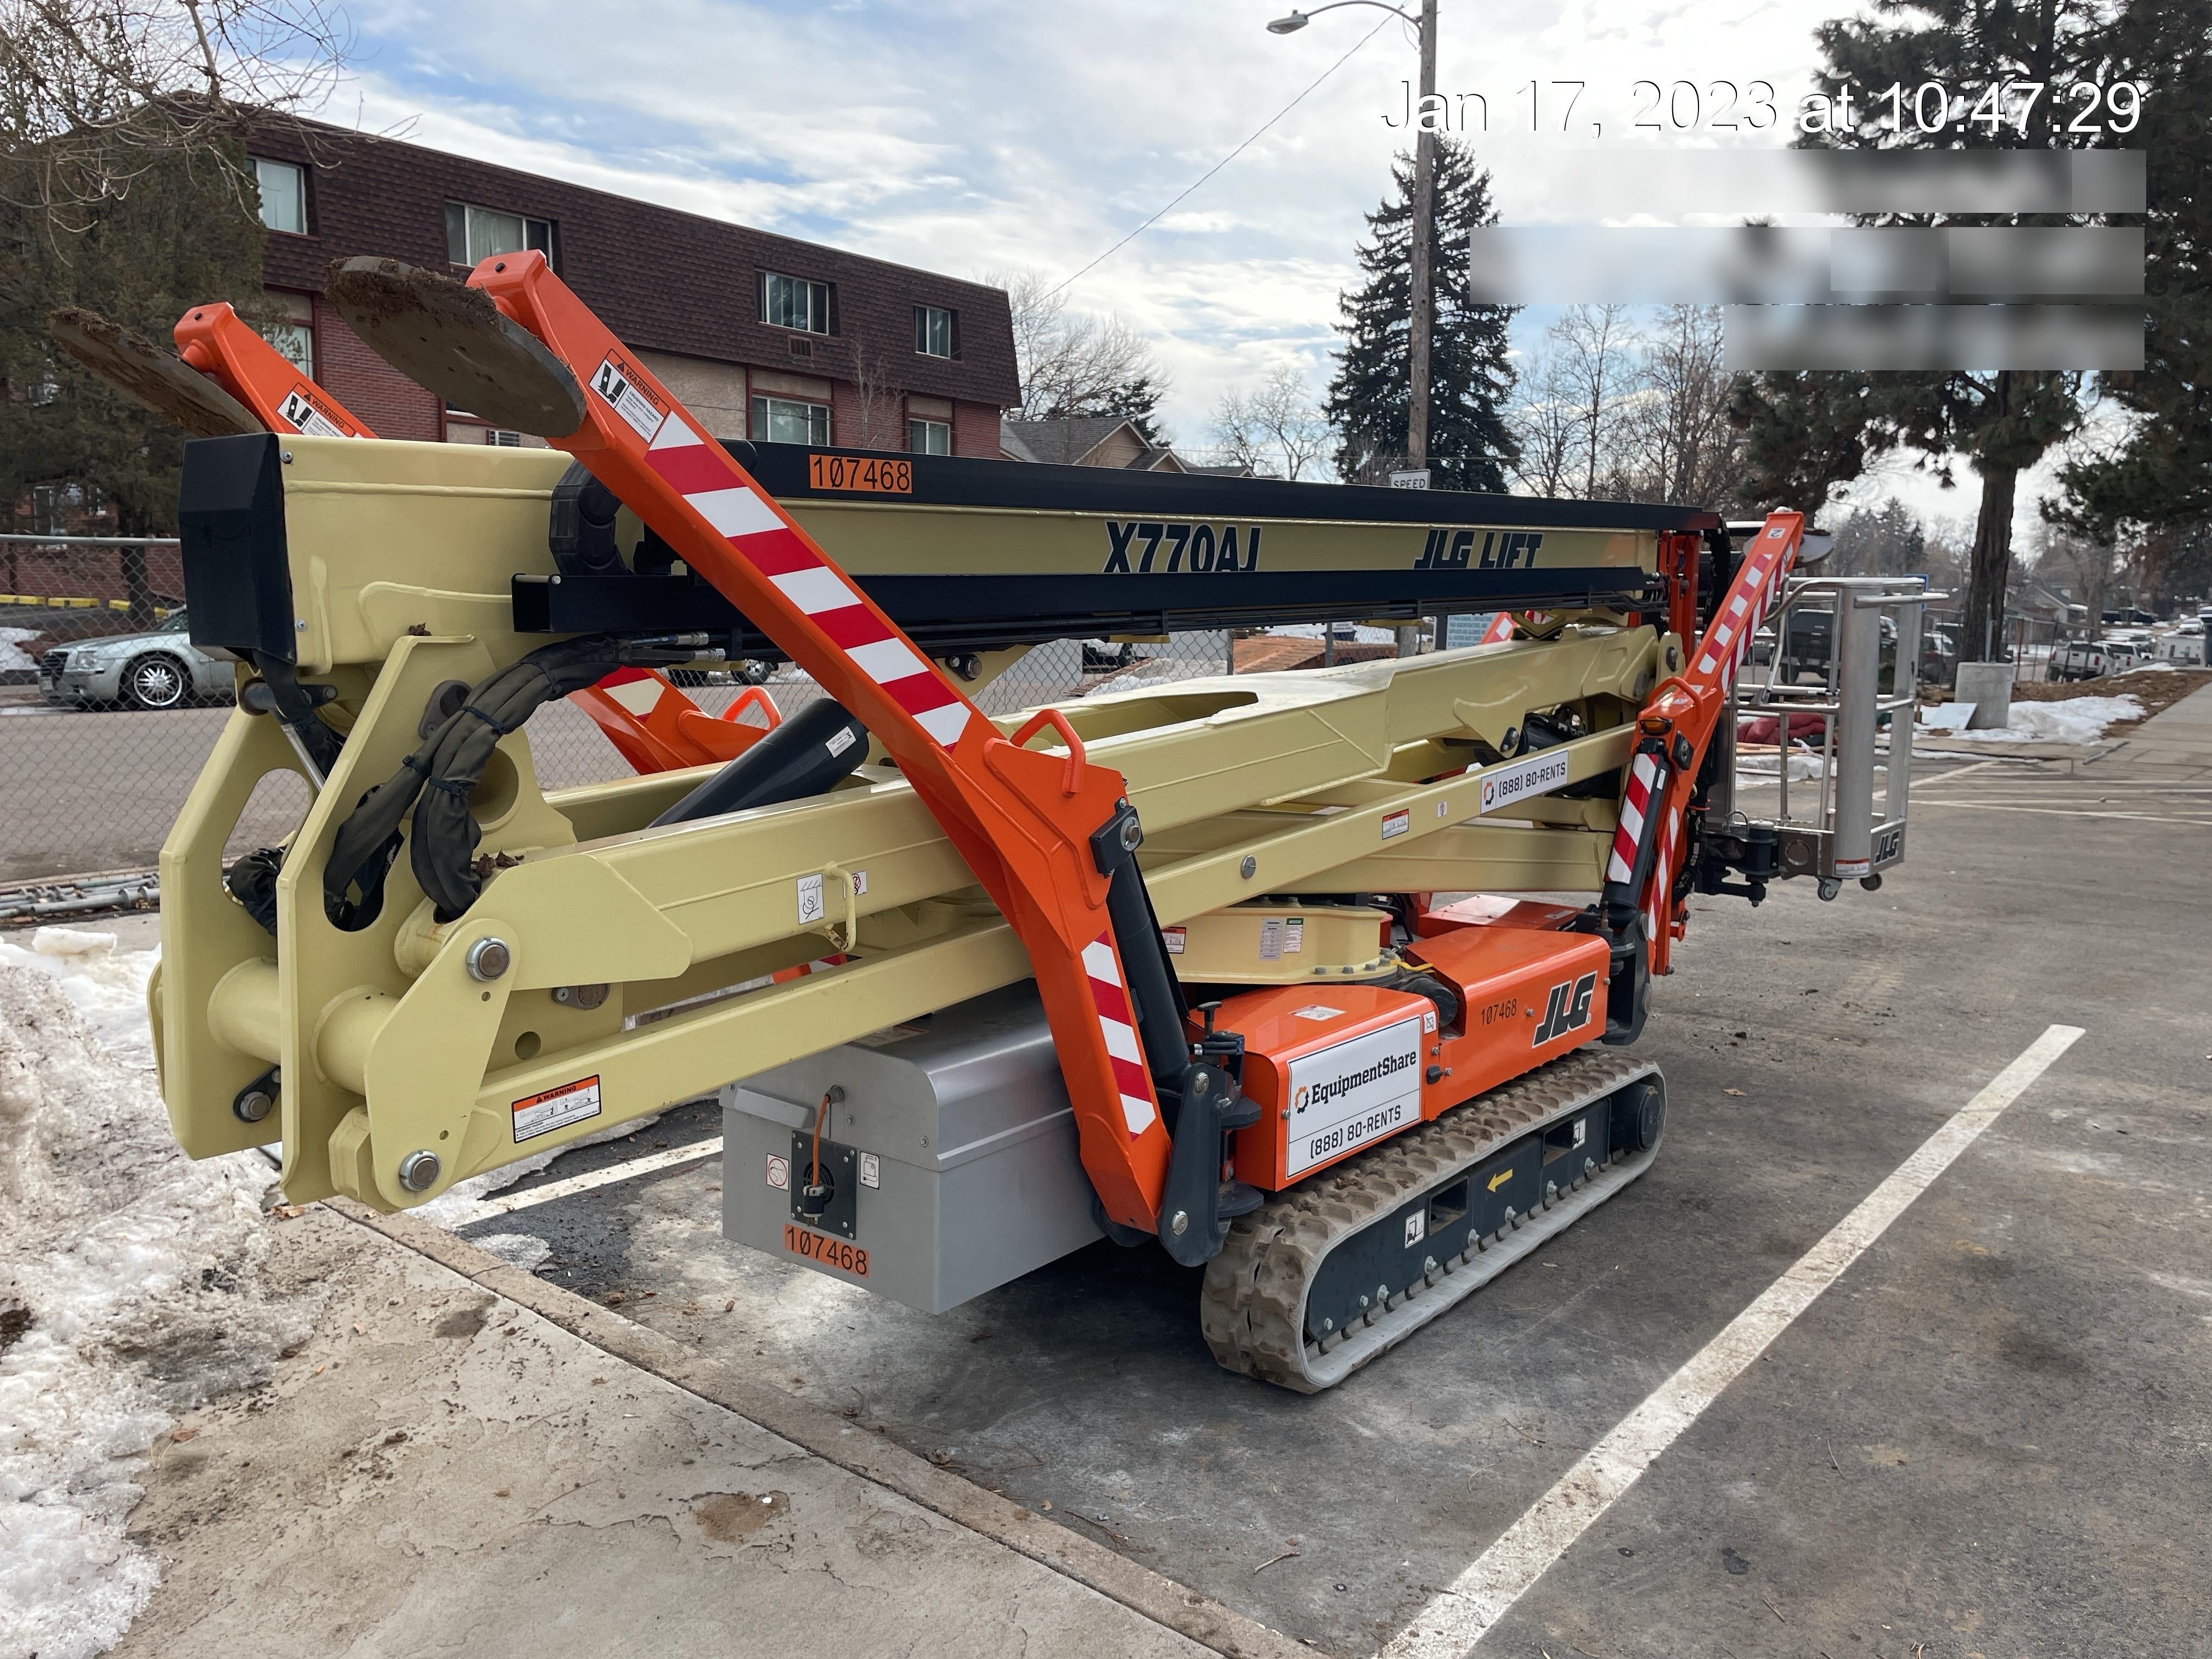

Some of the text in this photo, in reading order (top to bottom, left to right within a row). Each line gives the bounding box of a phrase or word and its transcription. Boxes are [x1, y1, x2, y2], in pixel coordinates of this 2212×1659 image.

[626, 368, 659, 405] WARNING
[313, 399, 345, 428] WARNING
[814, 456, 910, 491] 107468
[1393, 478, 1425, 488] SPEED
[1102, 520, 1261, 573] X770AJ
[1413, 529, 1544, 569] JLG LIFT
[1499, 761, 1565, 798] (888) 80-RENTS
[1874, 829, 1901, 865] JLG
[1481, 998, 1517, 1026] 107468
[1532, 970, 1598, 1049] JLG
[544, 1085, 577, 1101] WARNING
[1311, 1051, 1417, 1104] EquipmentShare
[1311, 1104, 1401, 1159] (888) 80-RENTS
[787, 1227, 867, 1275] 107468
